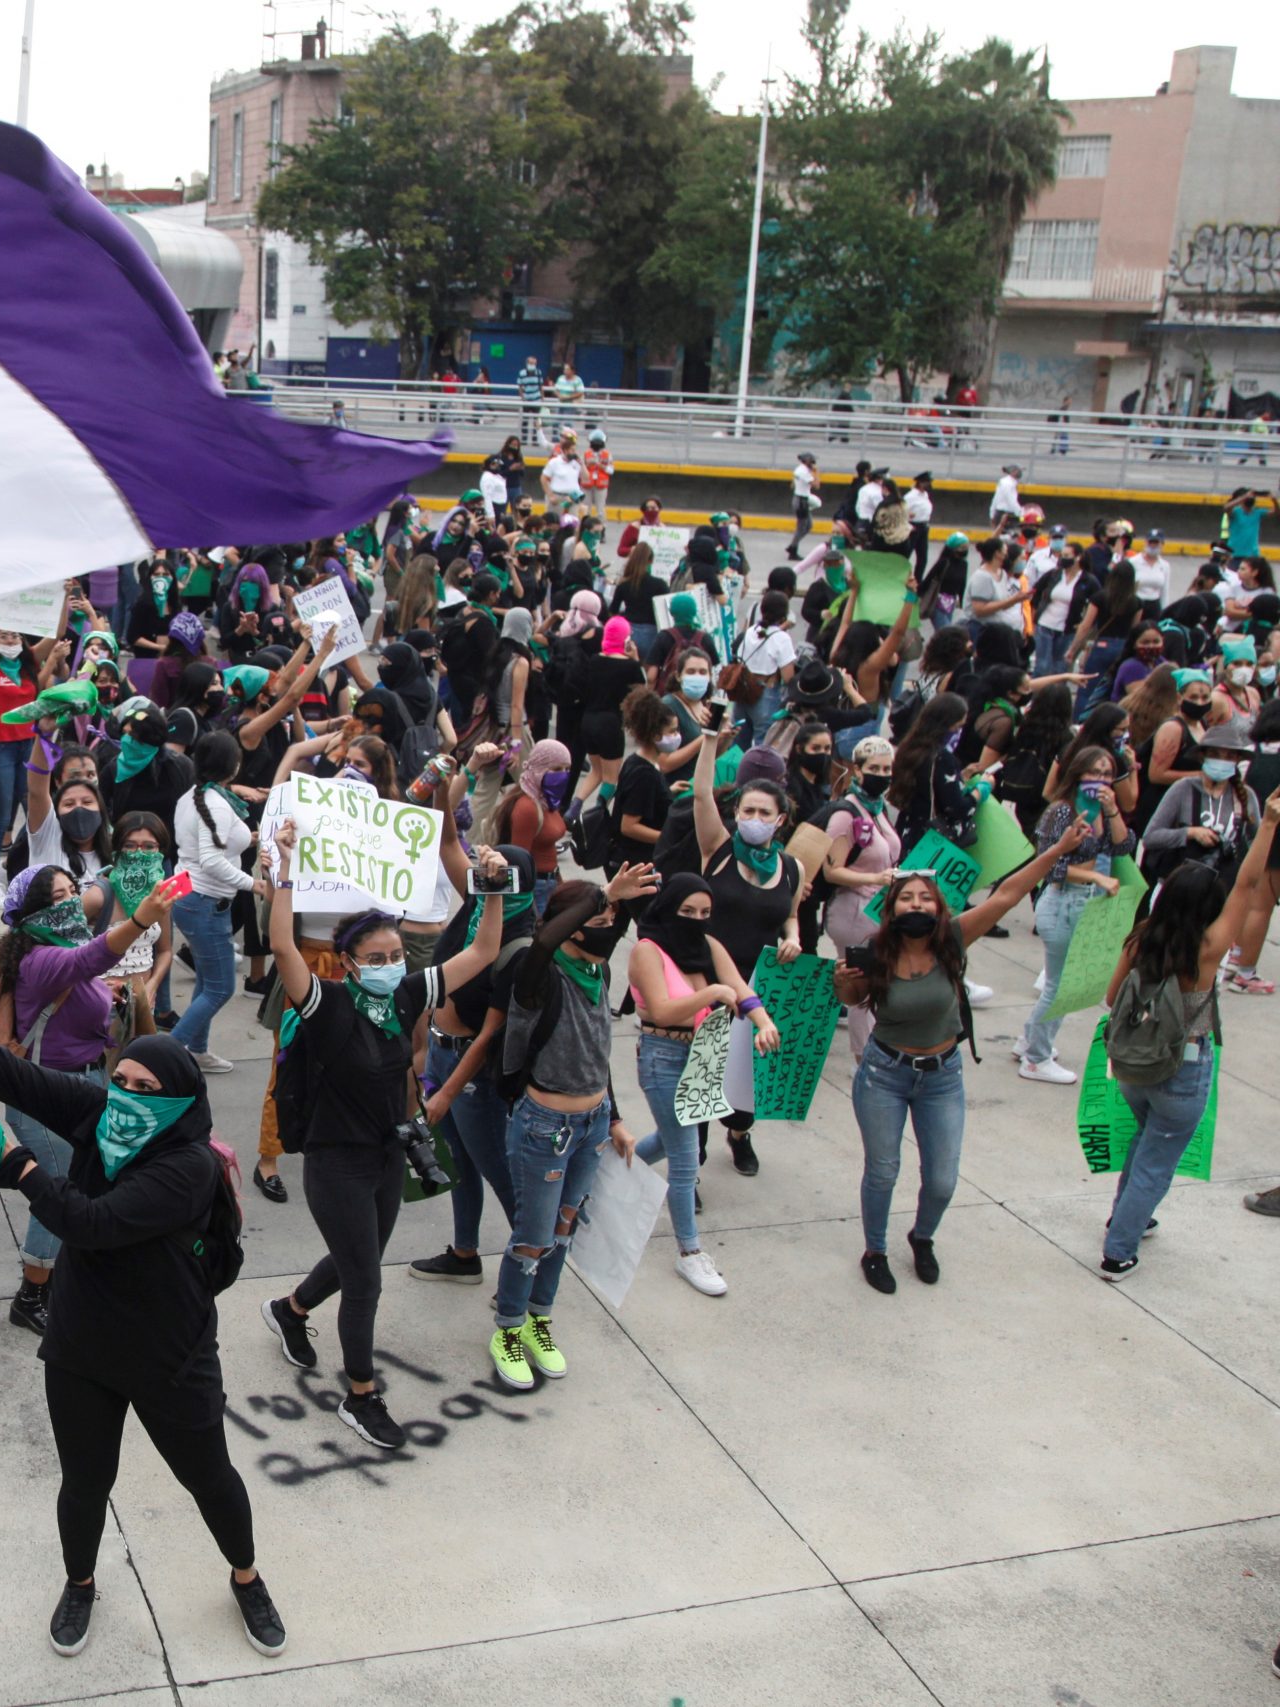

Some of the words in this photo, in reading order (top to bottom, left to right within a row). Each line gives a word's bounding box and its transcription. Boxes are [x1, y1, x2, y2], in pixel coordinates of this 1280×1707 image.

[297, 777, 390, 828] EXISTO
[298, 836, 414, 903] RESISTO
[928, 847, 980, 898] LIBE
[1078, 1124, 1111, 1174] HARTA
